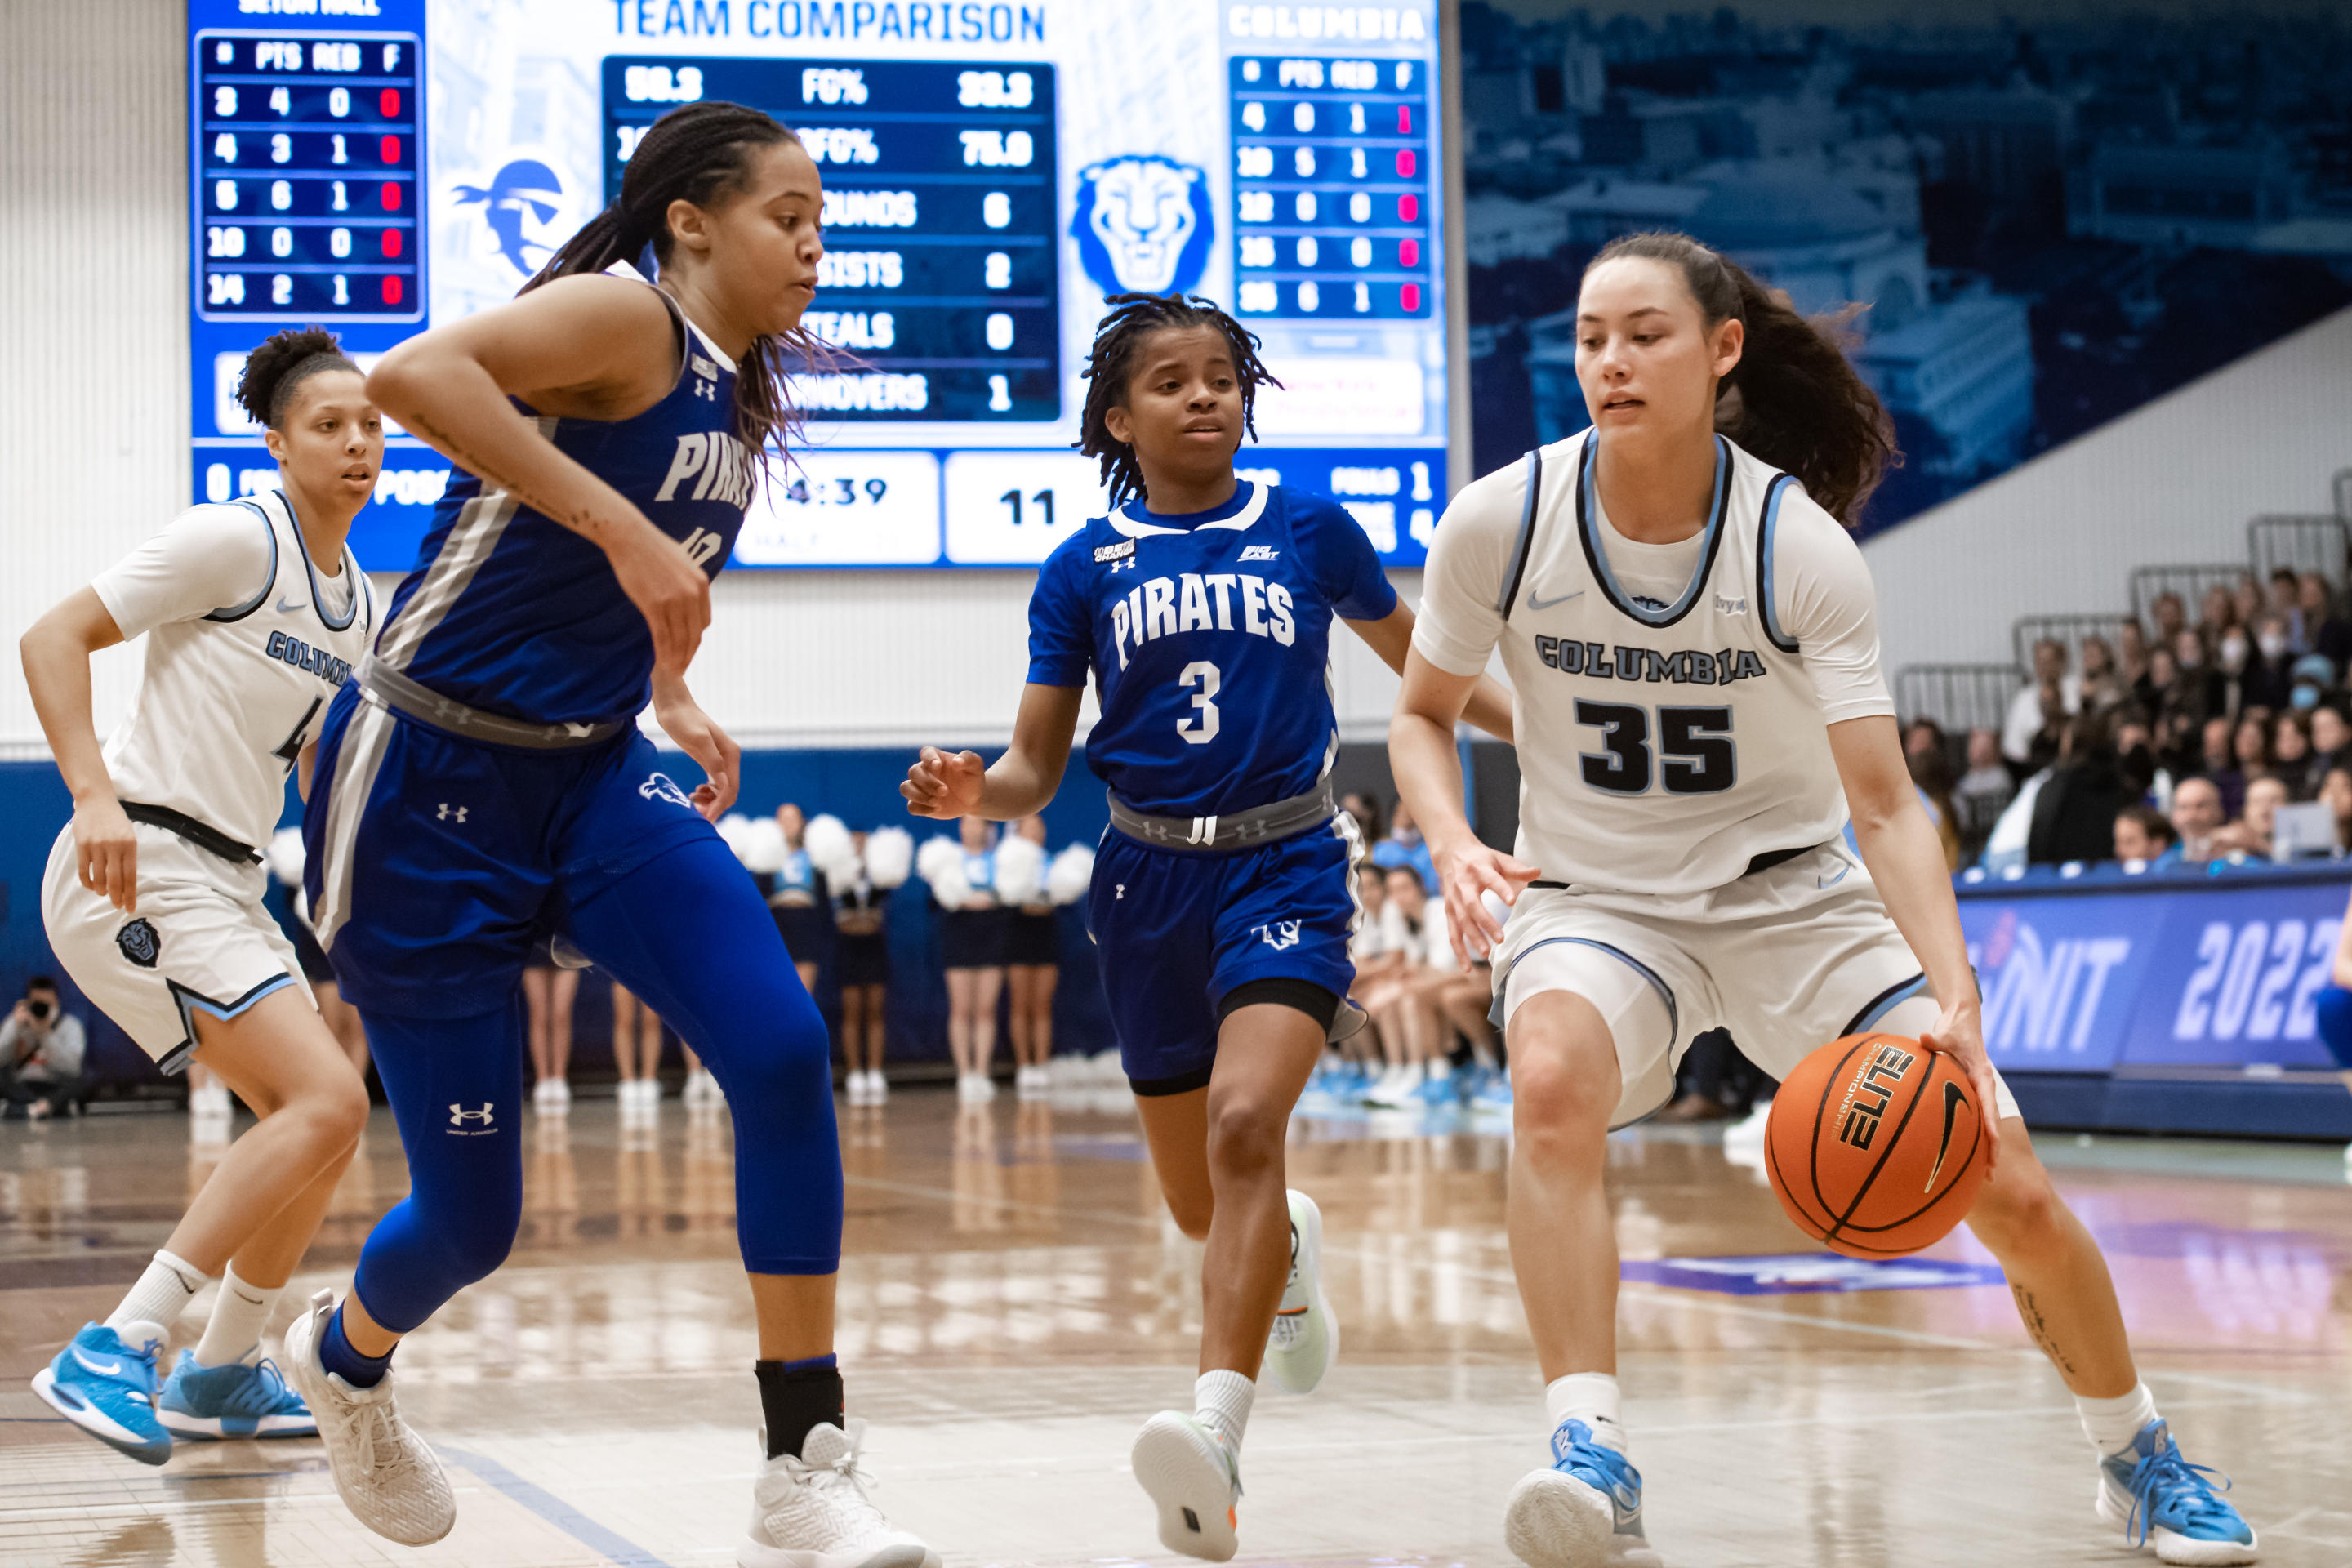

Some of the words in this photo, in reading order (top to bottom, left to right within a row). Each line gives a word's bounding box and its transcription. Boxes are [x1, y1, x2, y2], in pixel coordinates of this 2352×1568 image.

[609, 0, 730, 37] TEAM
[748, 1, 1045, 42] COMPARISON
[1229, 5, 1425, 40] COLUMBIA
[329, 87, 350, 117] 0
[381, 89, 400, 117] 0
[1350, 102, 1366, 133] 1
[332, 134, 348, 163] 1
[381, 135, 400, 163] 0
[332, 180, 349, 211] 1
[381, 182, 401, 211] 0
[820, 189, 918, 227] OUNDS
[271, 227, 292, 257] 0
[330, 228, 351, 258] 0
[381, 229, 402, 257] 0
[816, 251, 904, 287] SISTS
[332, 274, 350, 305] 1
[382, 275, 402, 305] 0
[988, 375, 1012, 411] 1
[786, 478, 887, 506] 4:39
[1000, 489, 1054, 525] 11
[1111, 572, 1295, 672] PIRATES
[1535, 635, 1766, 686] COLUMBIA
[1177, 661, 1220, 744] 3
[1573, 697, 1738, 797] 35
[2173, 919, 2342, 1041] 2022
[1831, 1043, 1882, 1140] CHAMPIONSHIP
[1839, 1045, 1917, 1151] ELITE
